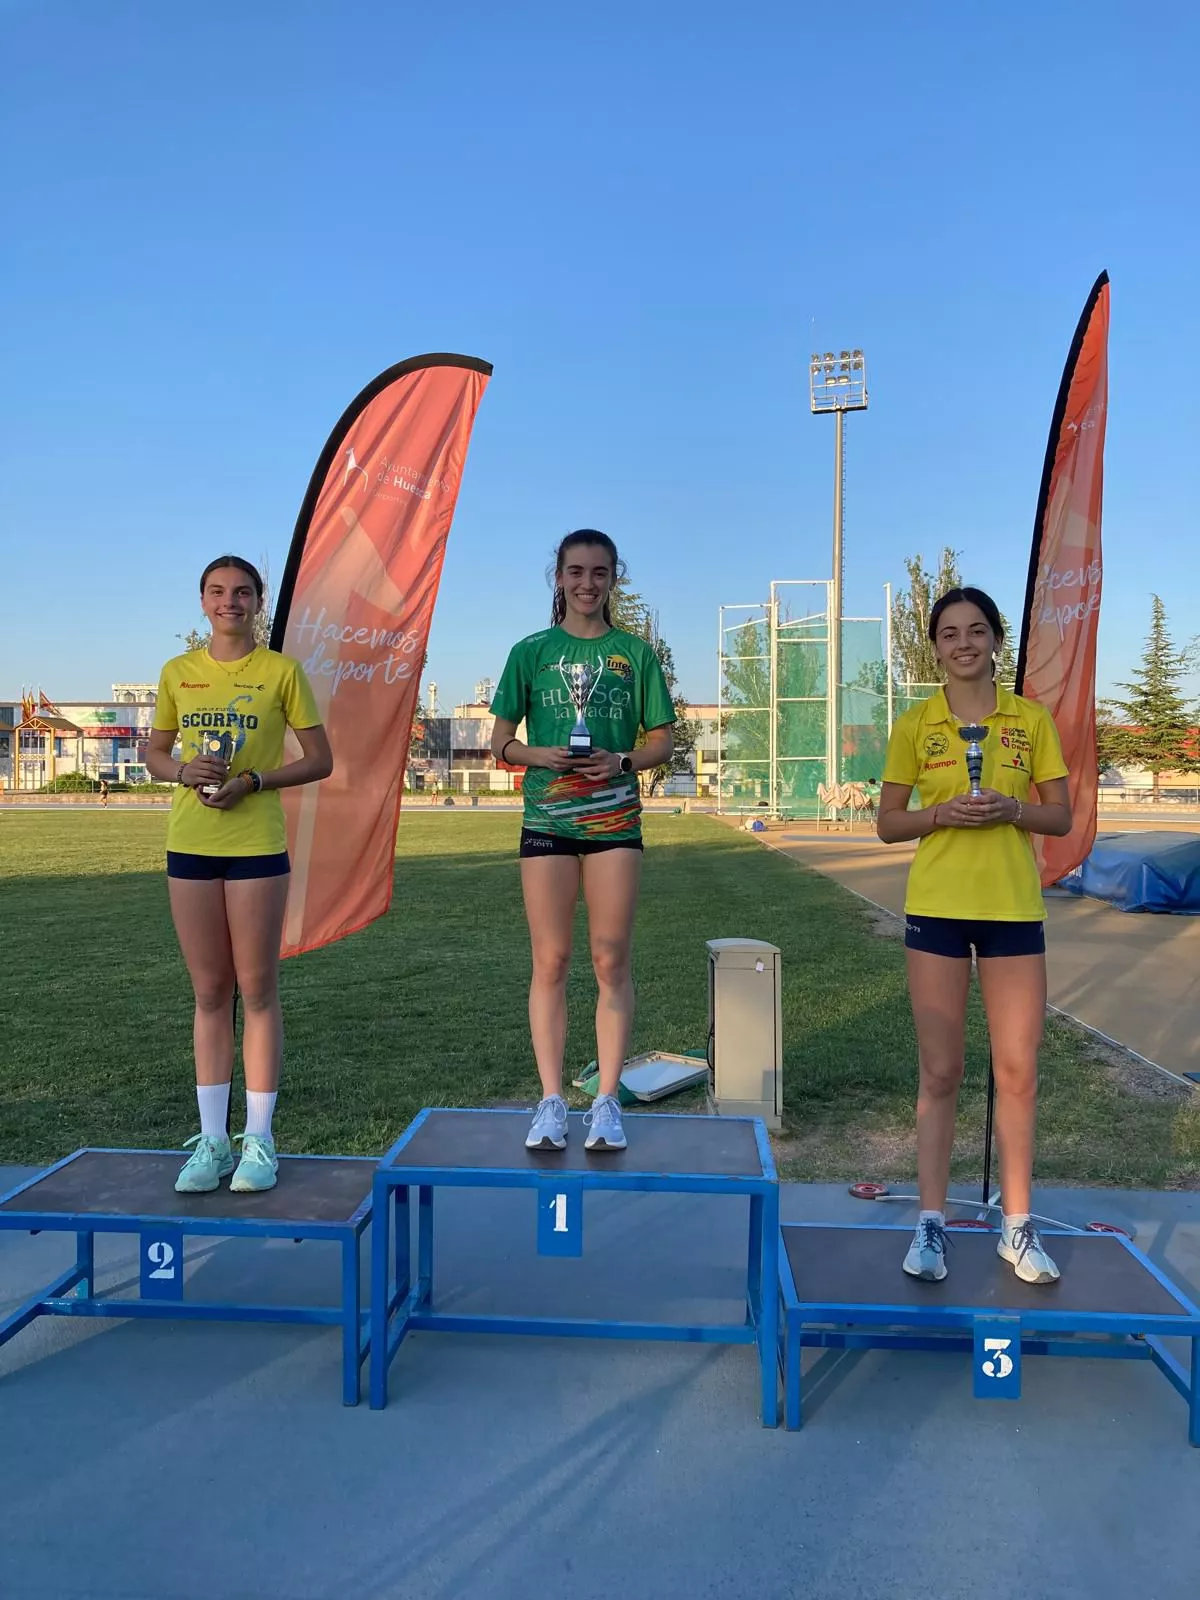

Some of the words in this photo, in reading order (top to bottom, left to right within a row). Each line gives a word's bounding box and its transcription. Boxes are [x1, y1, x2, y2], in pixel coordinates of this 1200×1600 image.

[377, 471, 390, 485] de
[295, 606, 420, 653] Hacemos
[302, 641, 412, 696] deporte
[182, 712, 258, 730] SCORPIO
[924, 760, 957, 771] Alcampo
[549, 1194, 568, 1232] 1
[148, 1242, 175, 1279] 2
[982, 1338, 1013, 1378] 3
